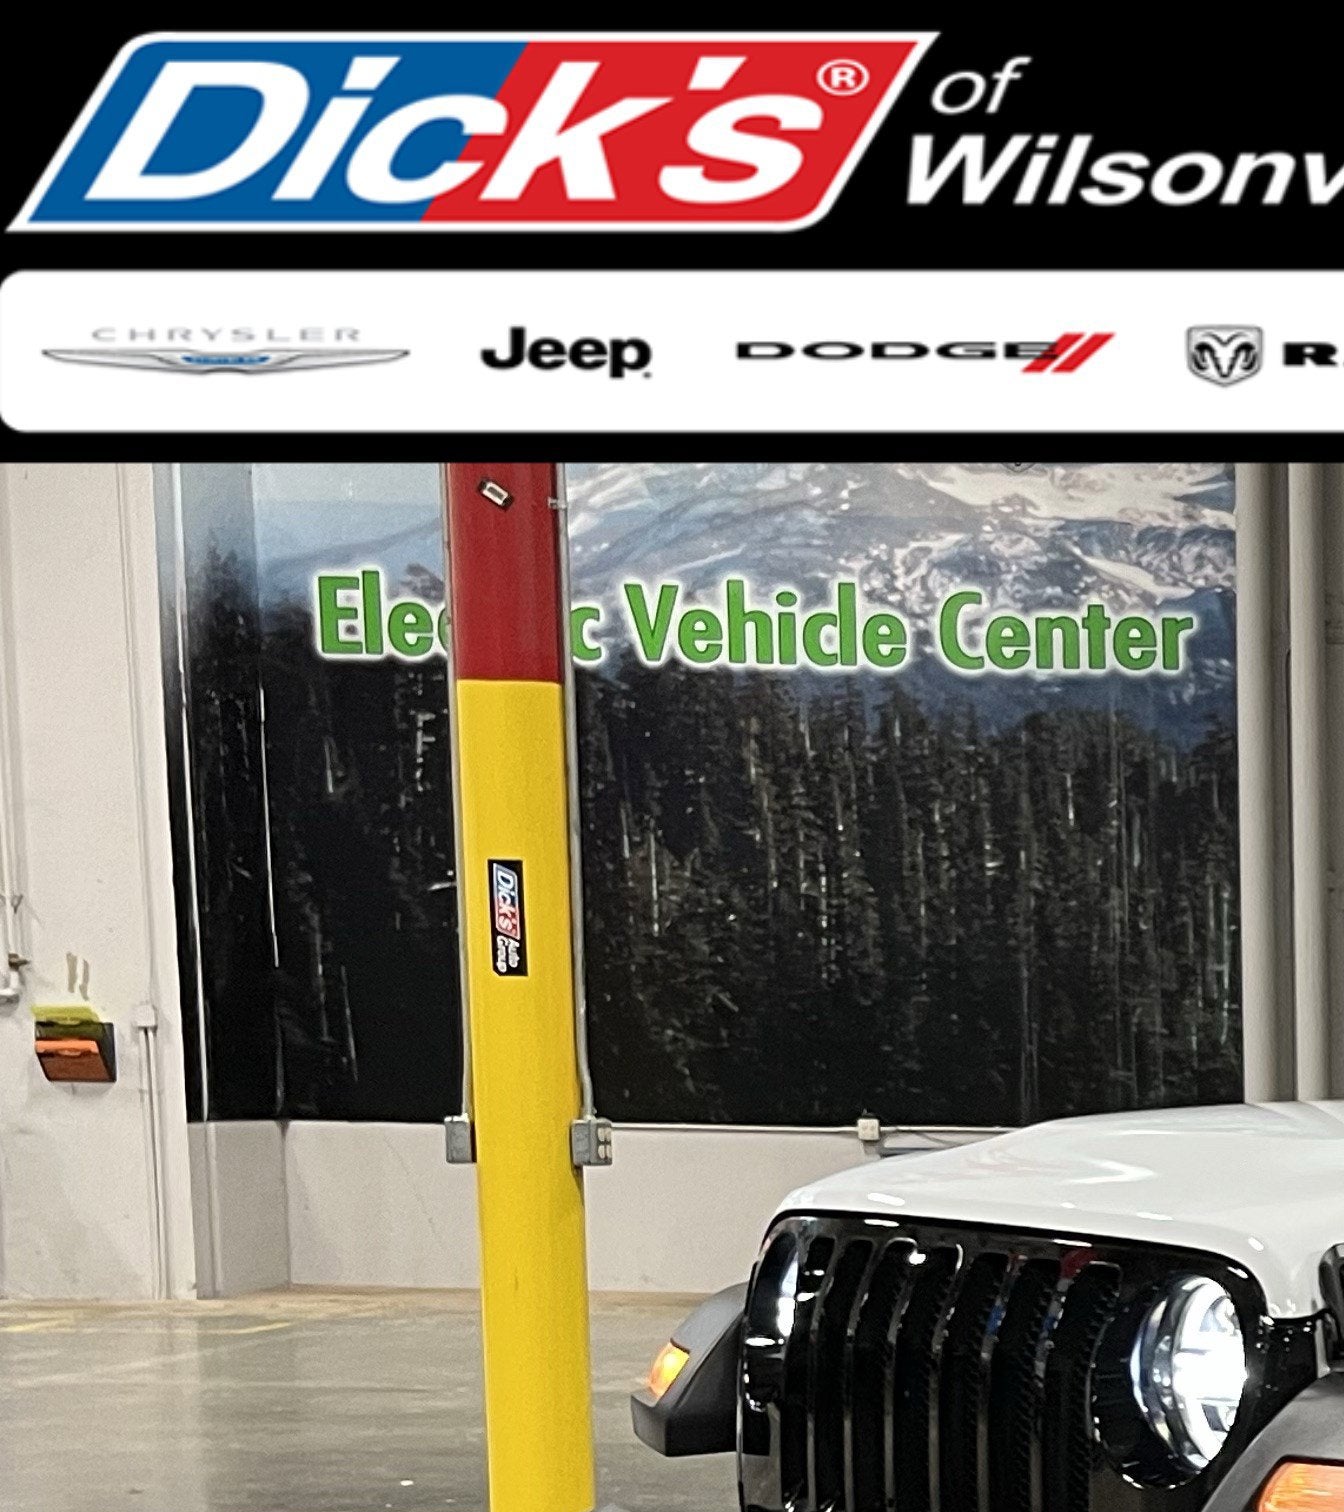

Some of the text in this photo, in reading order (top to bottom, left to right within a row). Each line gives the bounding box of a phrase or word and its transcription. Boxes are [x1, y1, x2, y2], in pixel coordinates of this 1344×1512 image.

[317, 569, 1194, 671] Elec Vehicle Center
[496, 869, 517, 932] Dick's
